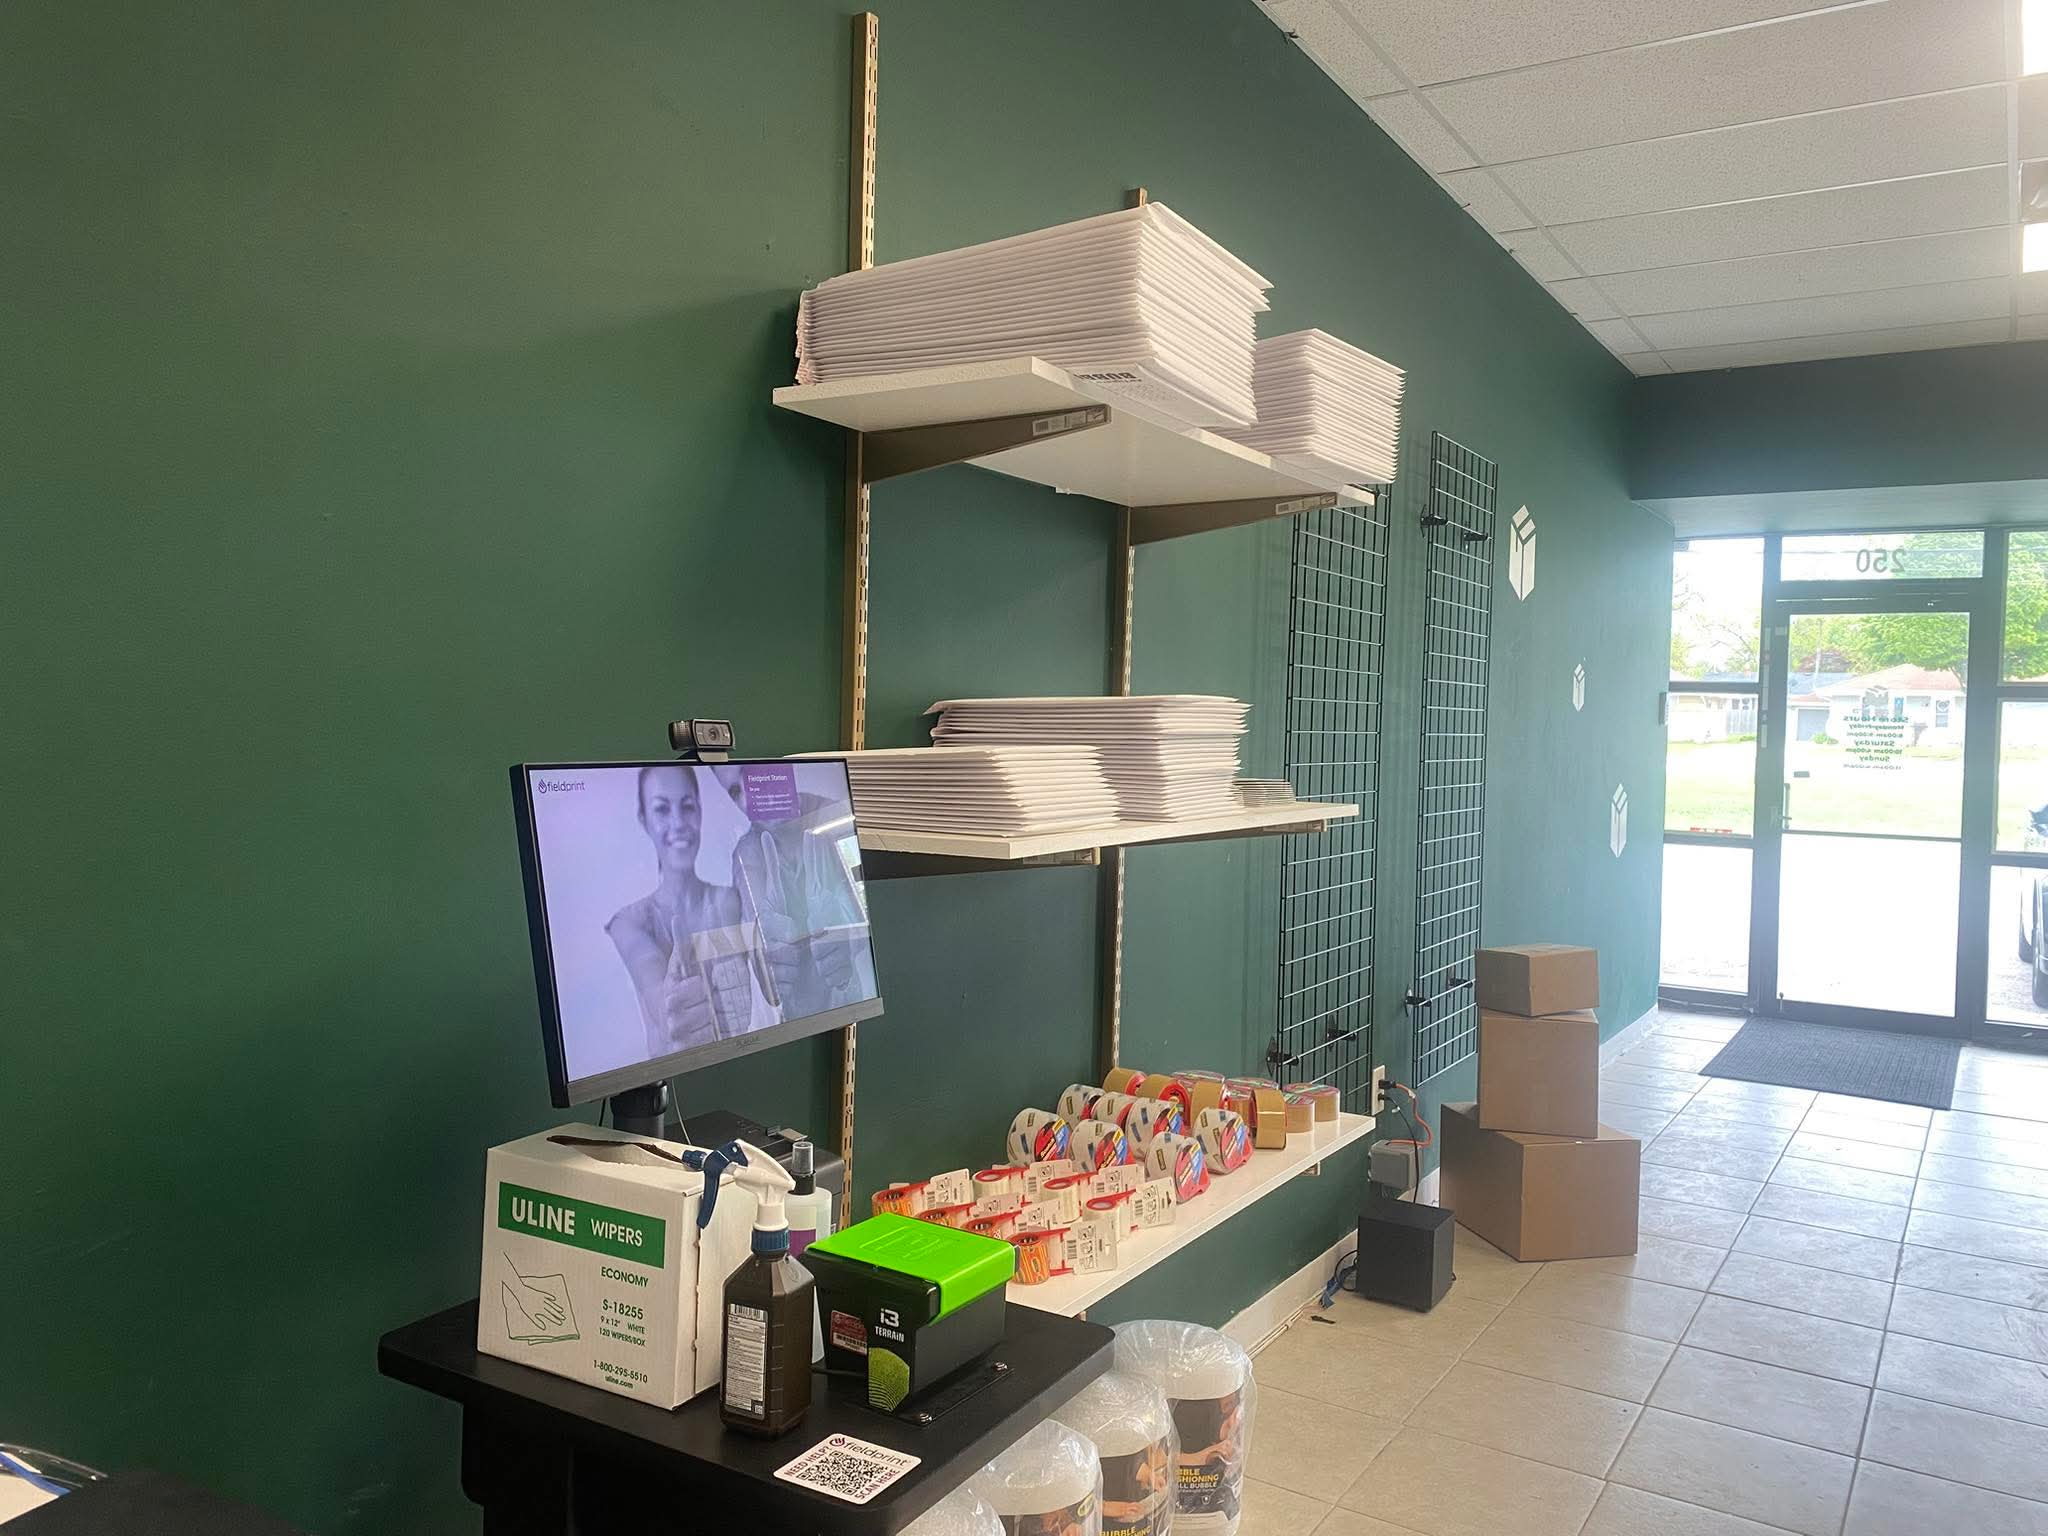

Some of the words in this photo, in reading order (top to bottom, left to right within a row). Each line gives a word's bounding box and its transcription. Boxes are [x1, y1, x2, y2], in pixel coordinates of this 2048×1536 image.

[547, 780, 585, 792] fieldprint
[512, 1196, 575, 1235] ULINE
[590, 1218, 643, 1248] WIPERS
[601, 1266, 648, 1287] ECONOMY
[602, 1299, 644, 1320] S-18255
[880, 1308, 899, 1328] i3
[599, 1327, 611, 1338] 120
[627, 1322, 646, 1335] WHITE
[593, 1359, 648, 1384] 1-800-295-5510
[605, 1375, 634, 1389] uline.com
[845, 1442, 908, 1467] fieldprint
[784, 1461, 807, 1477] NEED
[854, 1483, 880, 1500] SCAN
[877, 1468, 900, 1485] HERE
